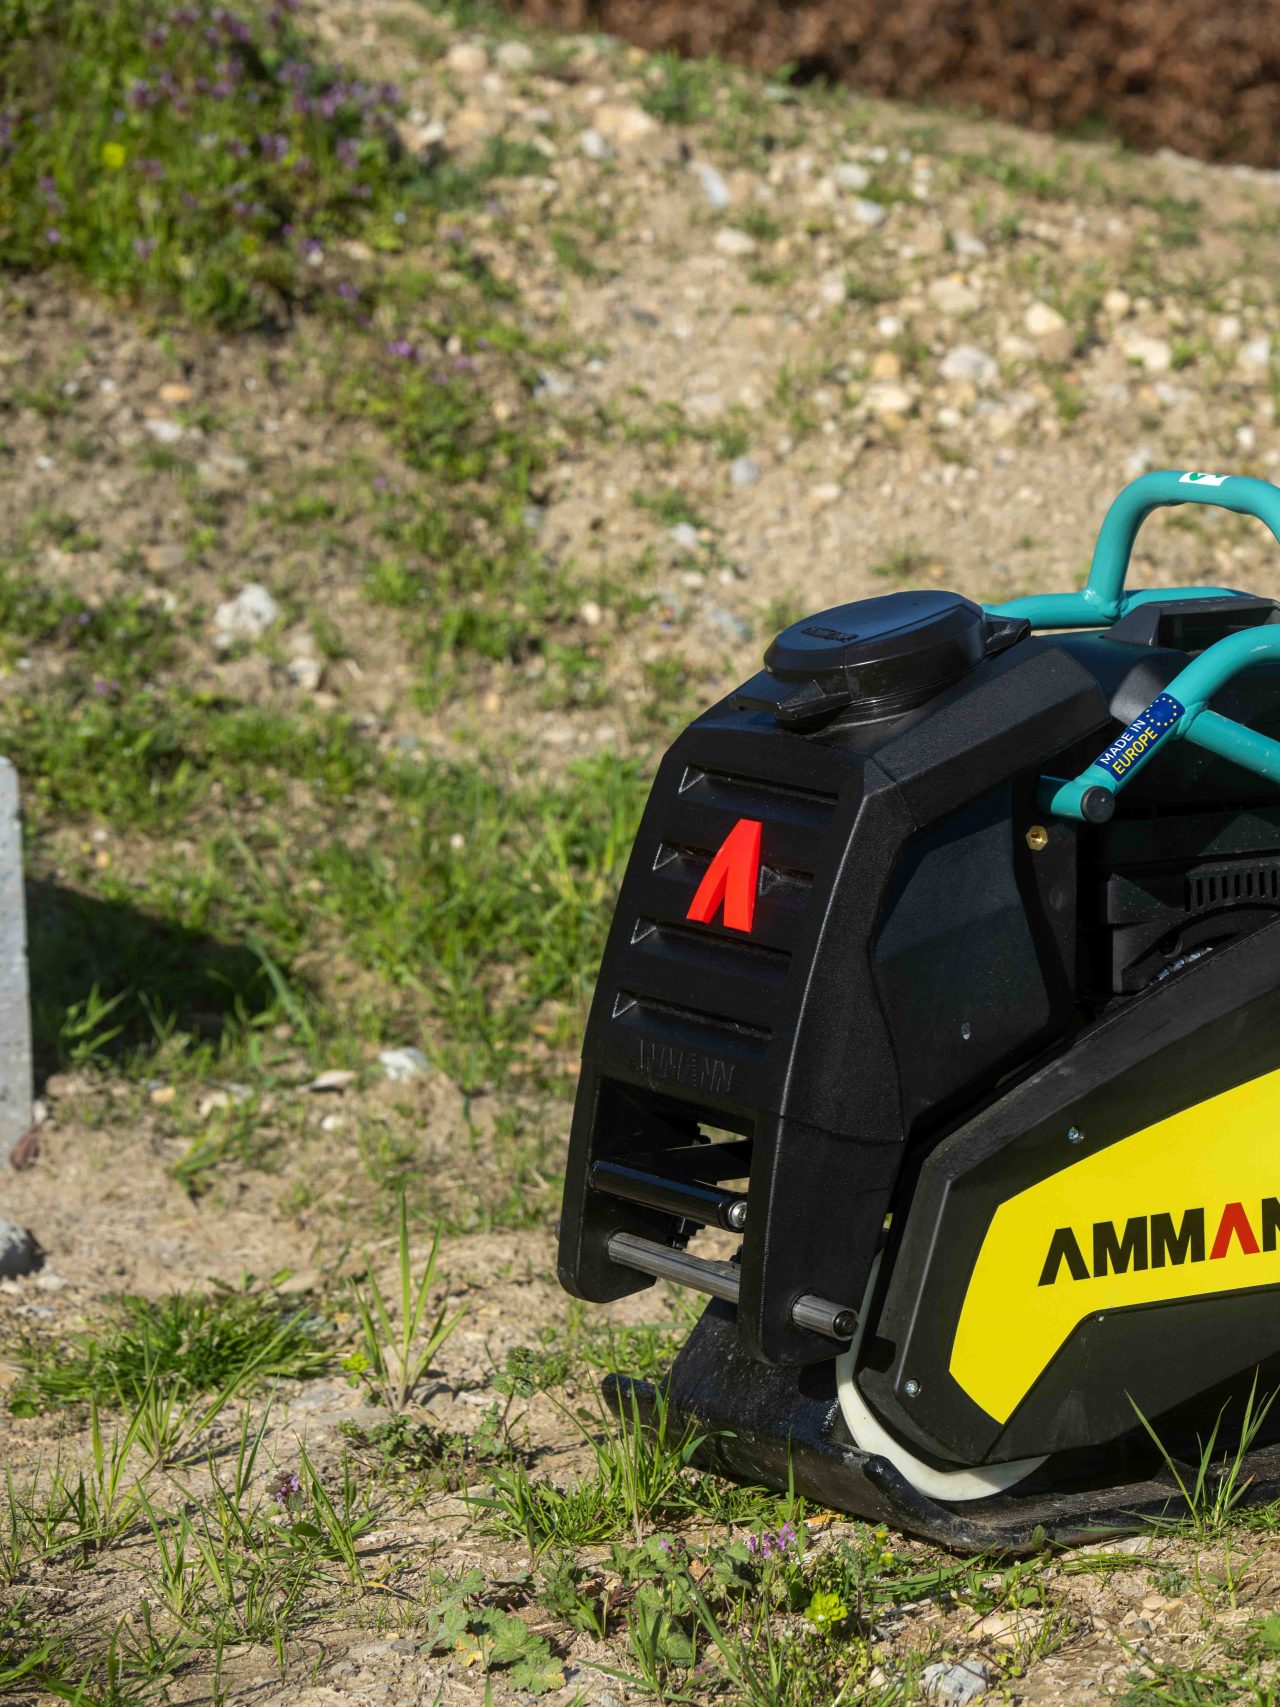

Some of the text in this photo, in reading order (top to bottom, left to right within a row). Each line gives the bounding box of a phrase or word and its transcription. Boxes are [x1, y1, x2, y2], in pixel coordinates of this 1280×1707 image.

[1100, 719, 1146, 764] MADE IN
[1113, 727, 1158, 774] EUROPE
